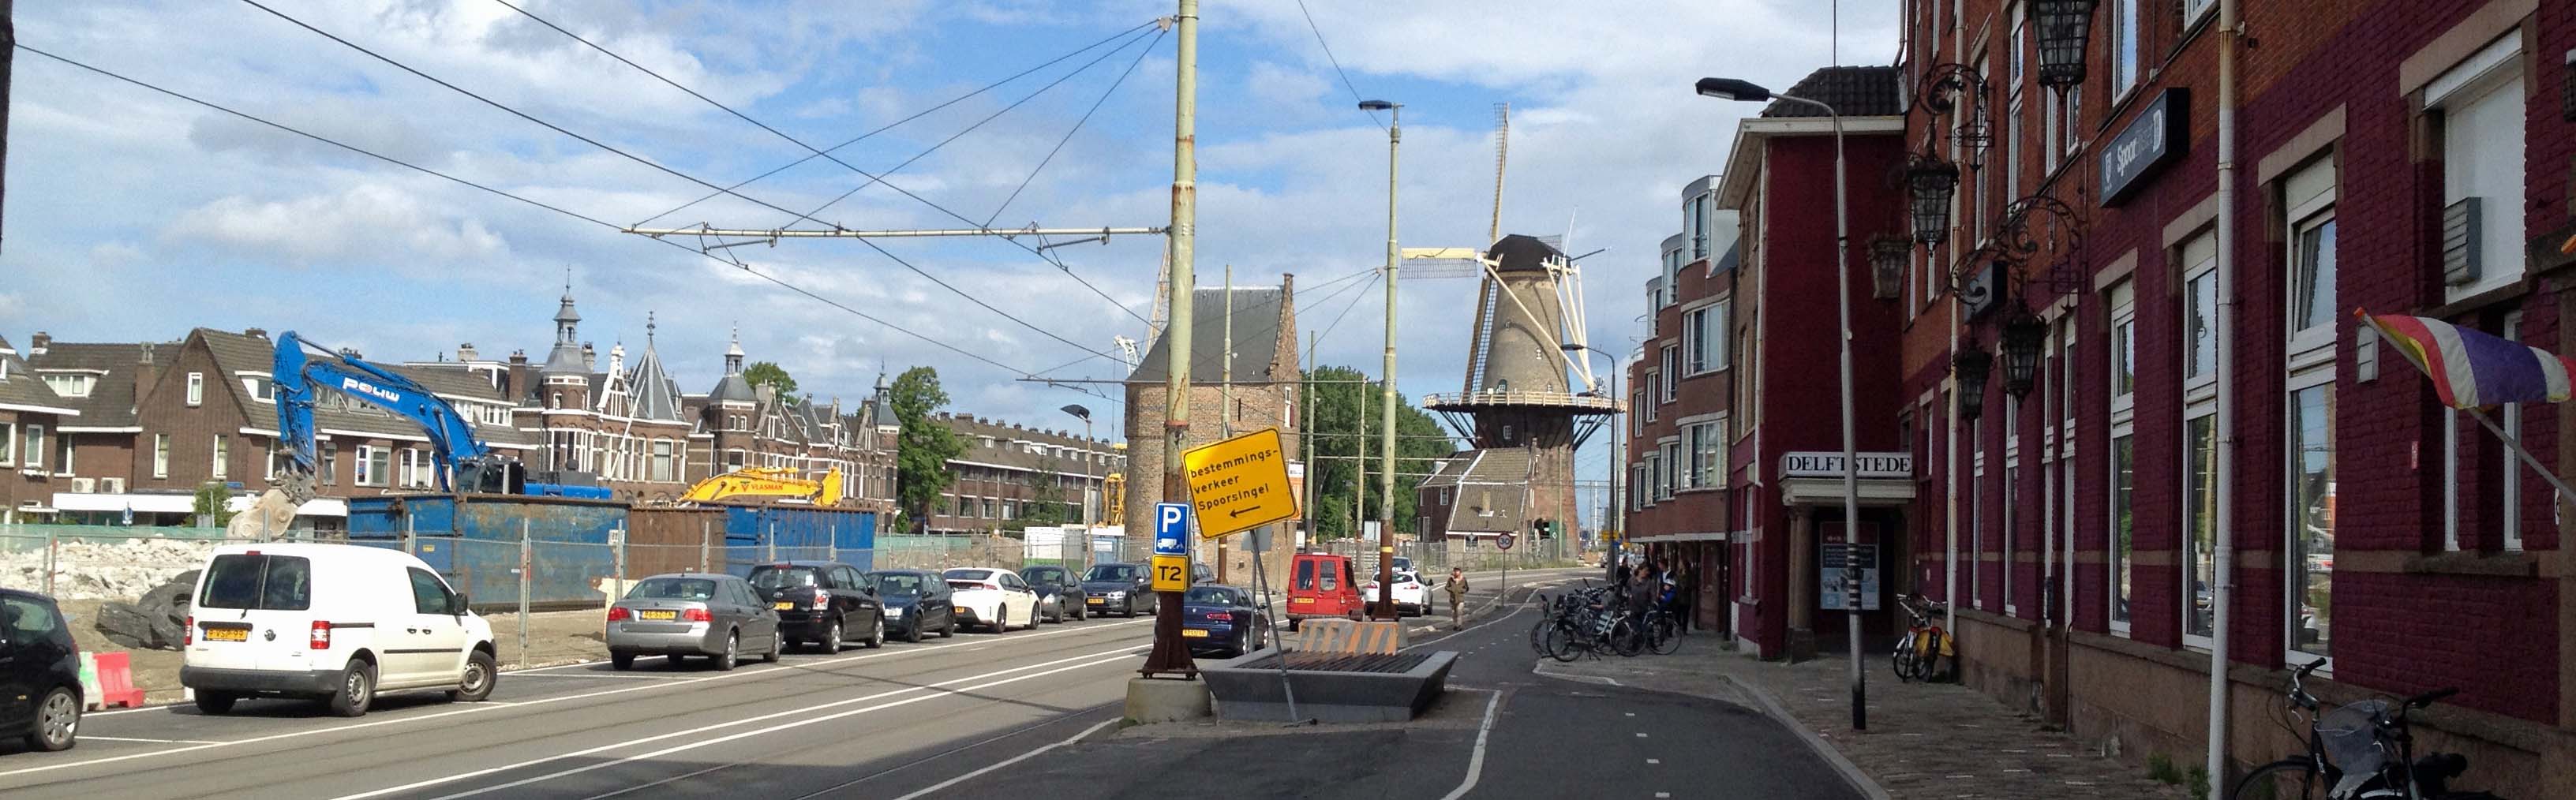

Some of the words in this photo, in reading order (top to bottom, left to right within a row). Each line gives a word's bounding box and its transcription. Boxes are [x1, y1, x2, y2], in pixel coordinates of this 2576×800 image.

[1190, 448, 1279, 478] bestemmings-
[1193, 475, 1240, 494] verkeer
[1197, 483, 1270, 511] Spoorsingel
[1162, 507, 1181, 533] P
[1158, 566, 1181, 581] T2
